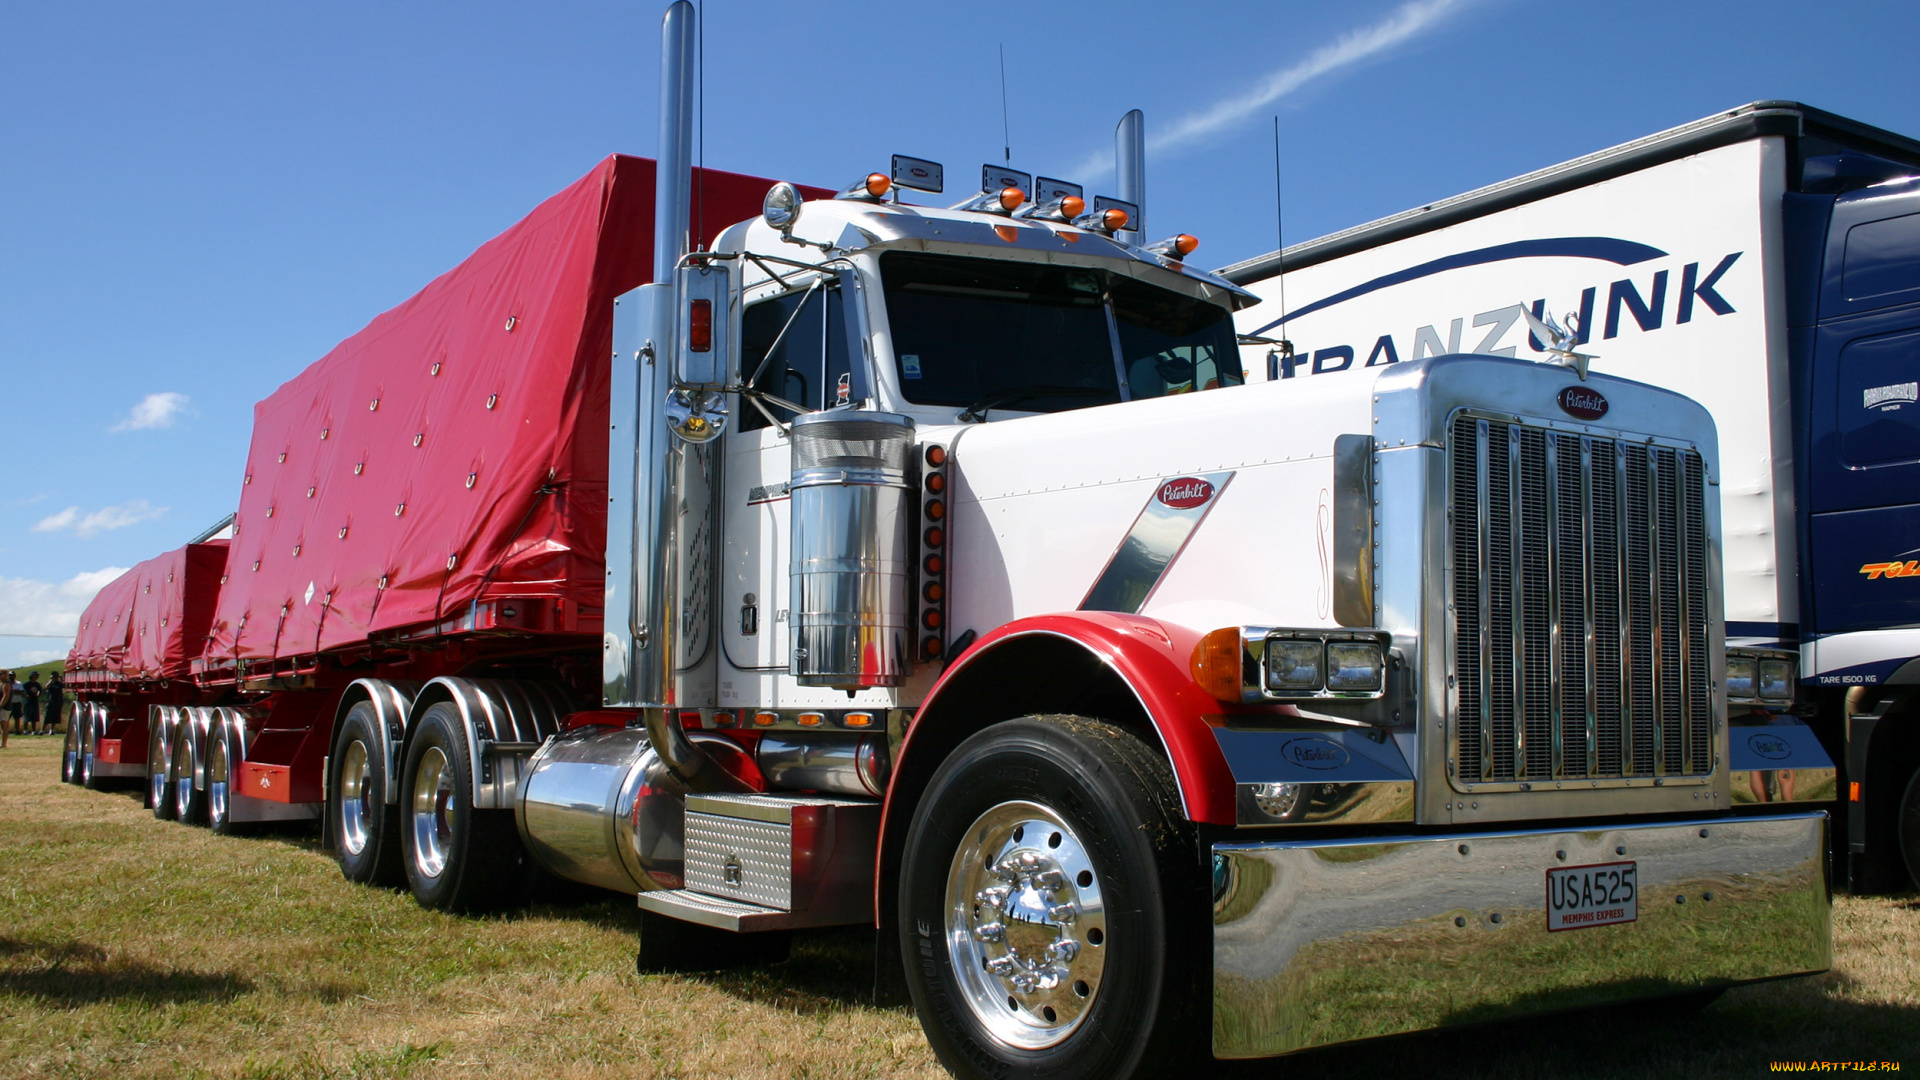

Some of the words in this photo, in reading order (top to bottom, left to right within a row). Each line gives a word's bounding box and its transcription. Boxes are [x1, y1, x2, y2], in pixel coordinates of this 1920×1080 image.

[1566, 390, 1605, 411] Peterbilt
[1163, 483, 1207, 502] Peterbilt
[1294, 746, 1337, 762] Peterbilt
[1552, 869, 1634, 910] USA525
[1562, 911, 1595, 924] MEMPHIS
[1596, 908, 1624, 921] EXPRESS
